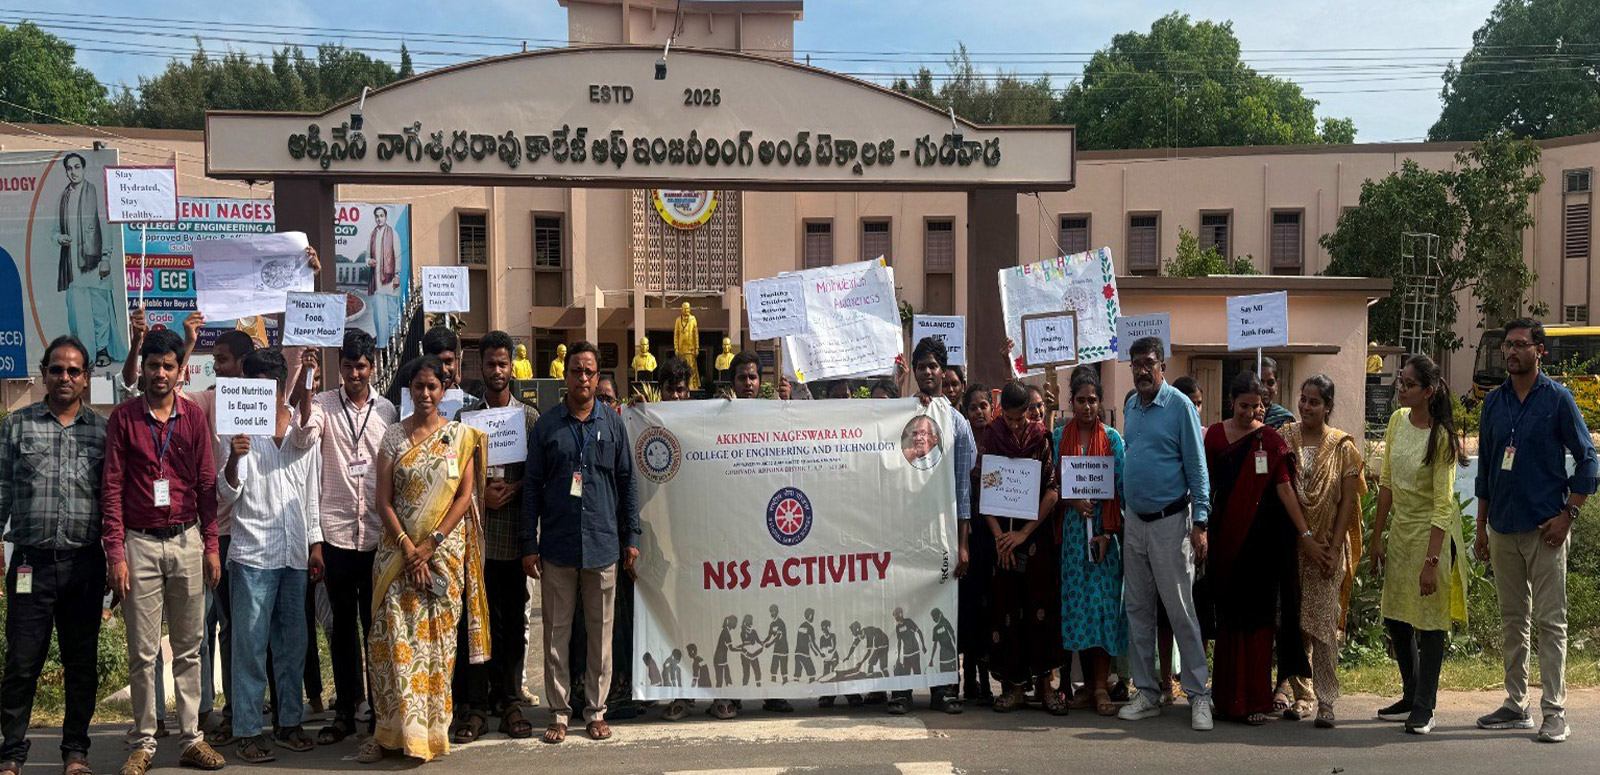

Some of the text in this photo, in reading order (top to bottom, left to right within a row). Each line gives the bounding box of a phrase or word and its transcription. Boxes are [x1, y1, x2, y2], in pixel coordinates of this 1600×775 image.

[589, 84, 722, 107] ESTD 2025
[757, 131, 812, 166] అండ్
[115, 169, 133, 180] Stay
[119, 182, 161, 193] Hydrated,
[120, 196, 138, 207] Stay
[216, 202, 275, 220] NAGES
[129, 222, 176, 231] COLLEGE
[178, 222, 193, 231] OF
[194, 222, 263, 232] ENGINEERING
[125, 256, 192, 268] Programmes
[161, 271, 187, 288] ECE
[132, 299, 163, 308] Avilable
[163, 299, 172, 307] for
[174, 299, 188, 309] Boys
[1240, 305, 1252, 313] Say
[148, 313, 173, 322] Code
[1138, 319, 1163, 327] CHILD
[1127, 328, 1161, 336] SHOULD
[1241, 329, 1256, 337] Junk
[221, 385, 273, 396] Good Nutrition
[228, 401, 268, 412] Is Equal To
[234, 416, 268, 426] Good Life
[488, 430, 518, 439] utrition,
[716, 427, 863, 446] AKKINENI NAGESWARA RAO
[685, 441, 896, 461] COLLEGE OF ENGINEERING AND TECHNOLOGY
[1070, 461, 1109, 470] Nutrition is
[1075, 474, 1104, 482] the Best
[702, 551, 892, 590] NSS ACTIVITY
